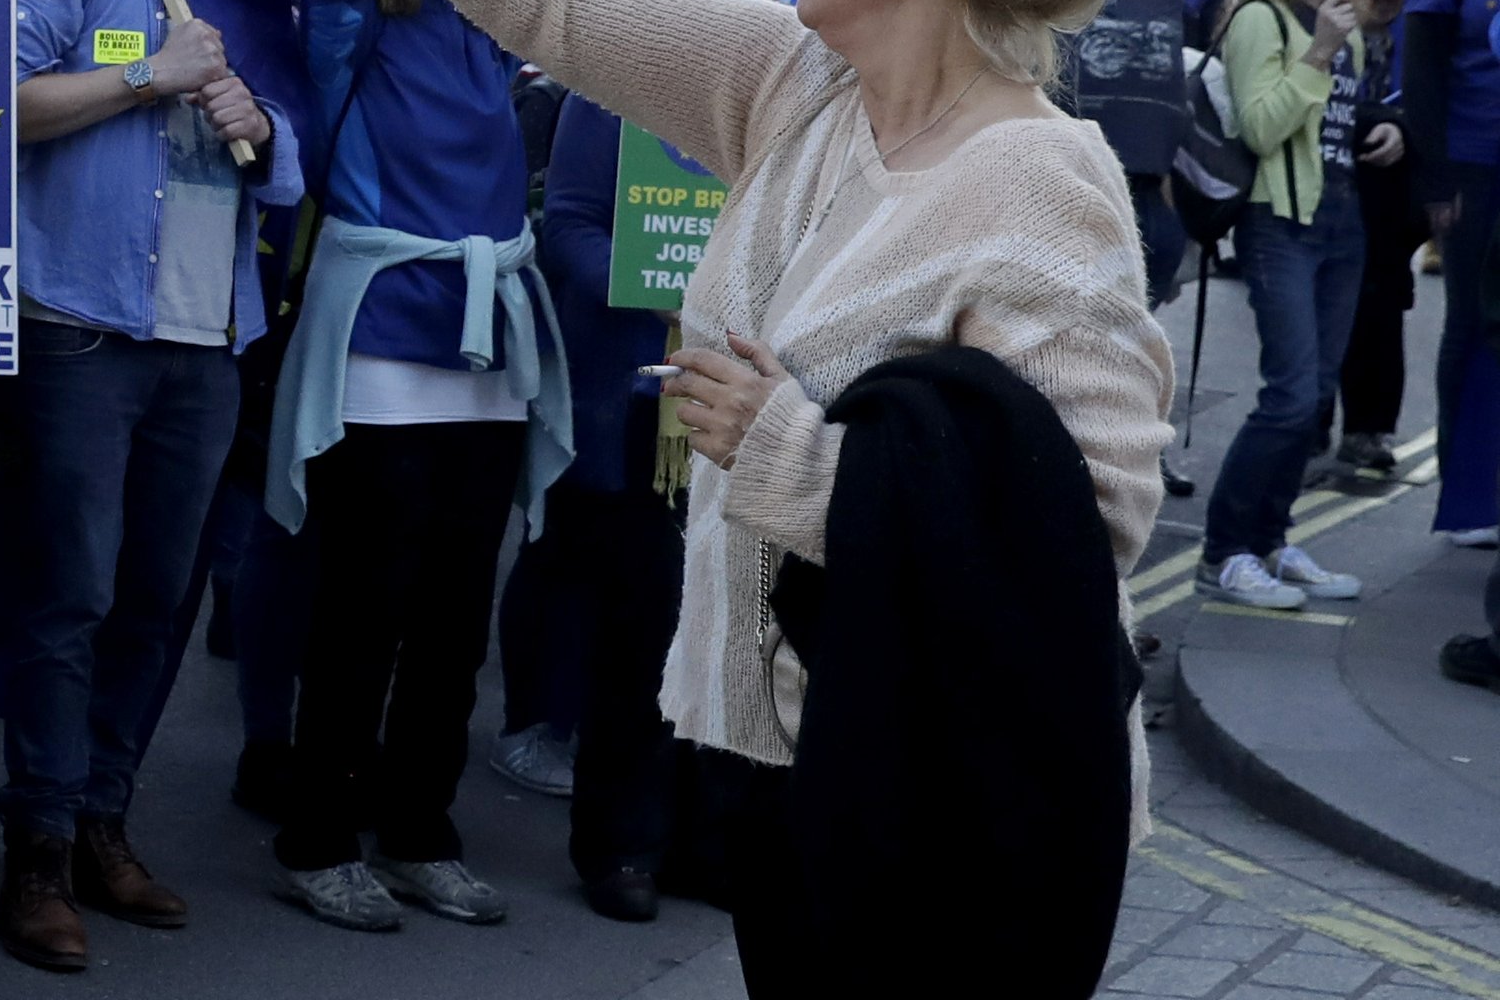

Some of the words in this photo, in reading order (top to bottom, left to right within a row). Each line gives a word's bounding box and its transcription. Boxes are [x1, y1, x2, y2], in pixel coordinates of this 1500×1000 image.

[99, 33, 140, 42] BOLLOCKS
[99, 41, 110, 49] TO
[112, 42, 140, 51] BREXIT
[627, 185, 688, 207] STOP
[694, 189, 729, 208] BR
[643, 214, 718, 237] INVES
[656, 243, 708, 263] JOB
[641, 269, 692, 290] TRA
